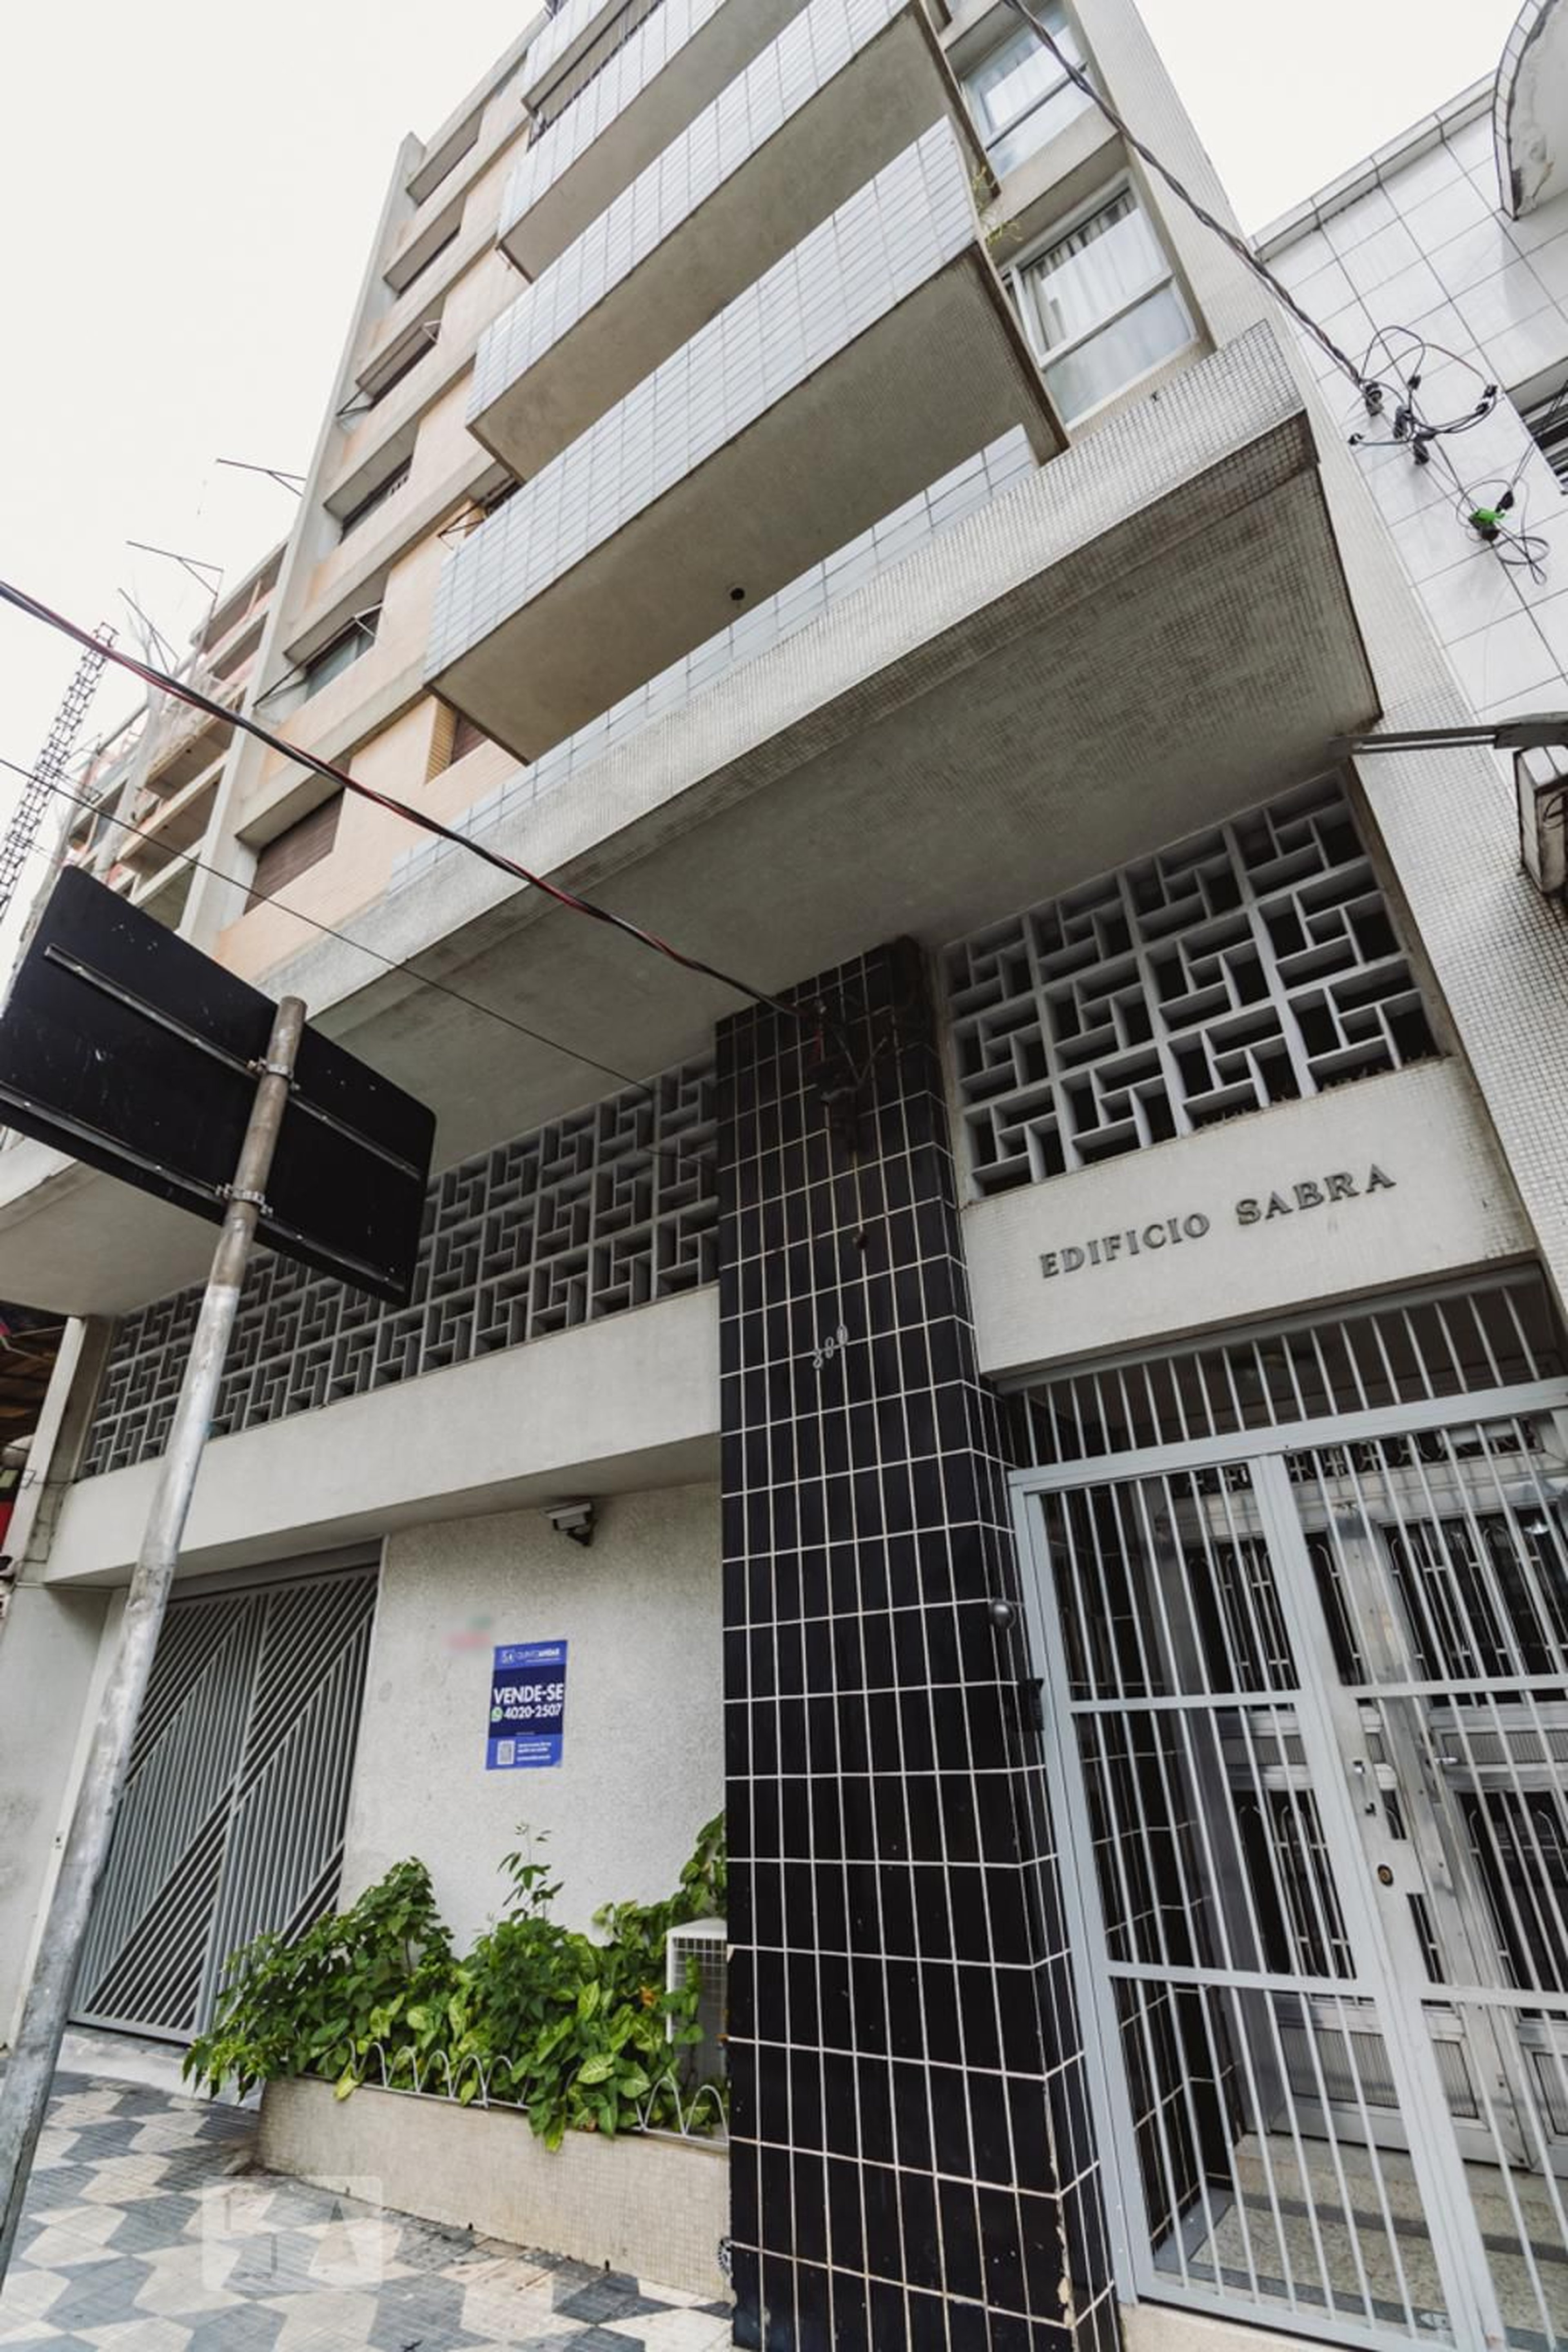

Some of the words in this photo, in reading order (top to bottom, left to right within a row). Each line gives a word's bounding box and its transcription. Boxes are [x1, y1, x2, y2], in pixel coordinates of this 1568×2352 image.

[1040, 1212, 1210, 1278] EDIFICIO
[1235, 1163, 1396, 1226] SABRA
[493, 1683, 564, 1705] VENDE-SE
